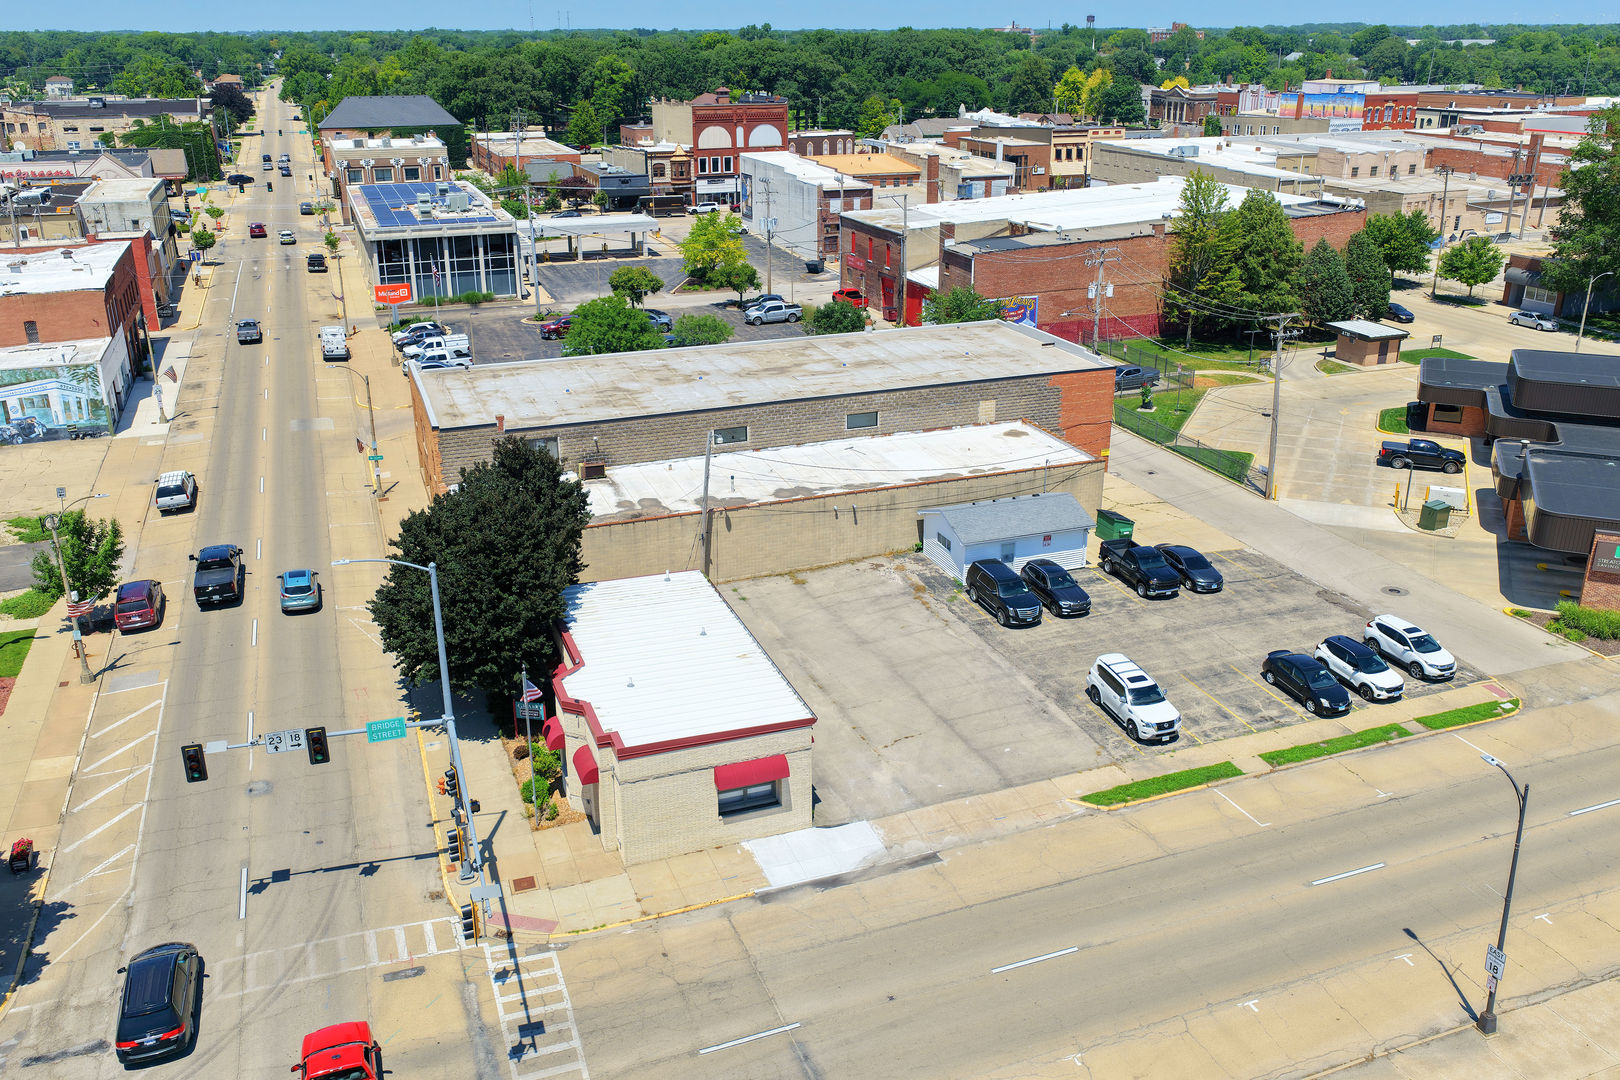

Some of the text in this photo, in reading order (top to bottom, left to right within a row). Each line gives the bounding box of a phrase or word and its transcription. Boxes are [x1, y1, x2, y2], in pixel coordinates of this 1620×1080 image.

[371, 720, 400, 731] BRIDGE
[289, 733, 301, 743] 18
[372, 729, 401, 740] STREET
[268, 735, 283, 746] 23
[1489, 946, 1504, 960] EAST
[1489, 961, 1499, 975] 18
